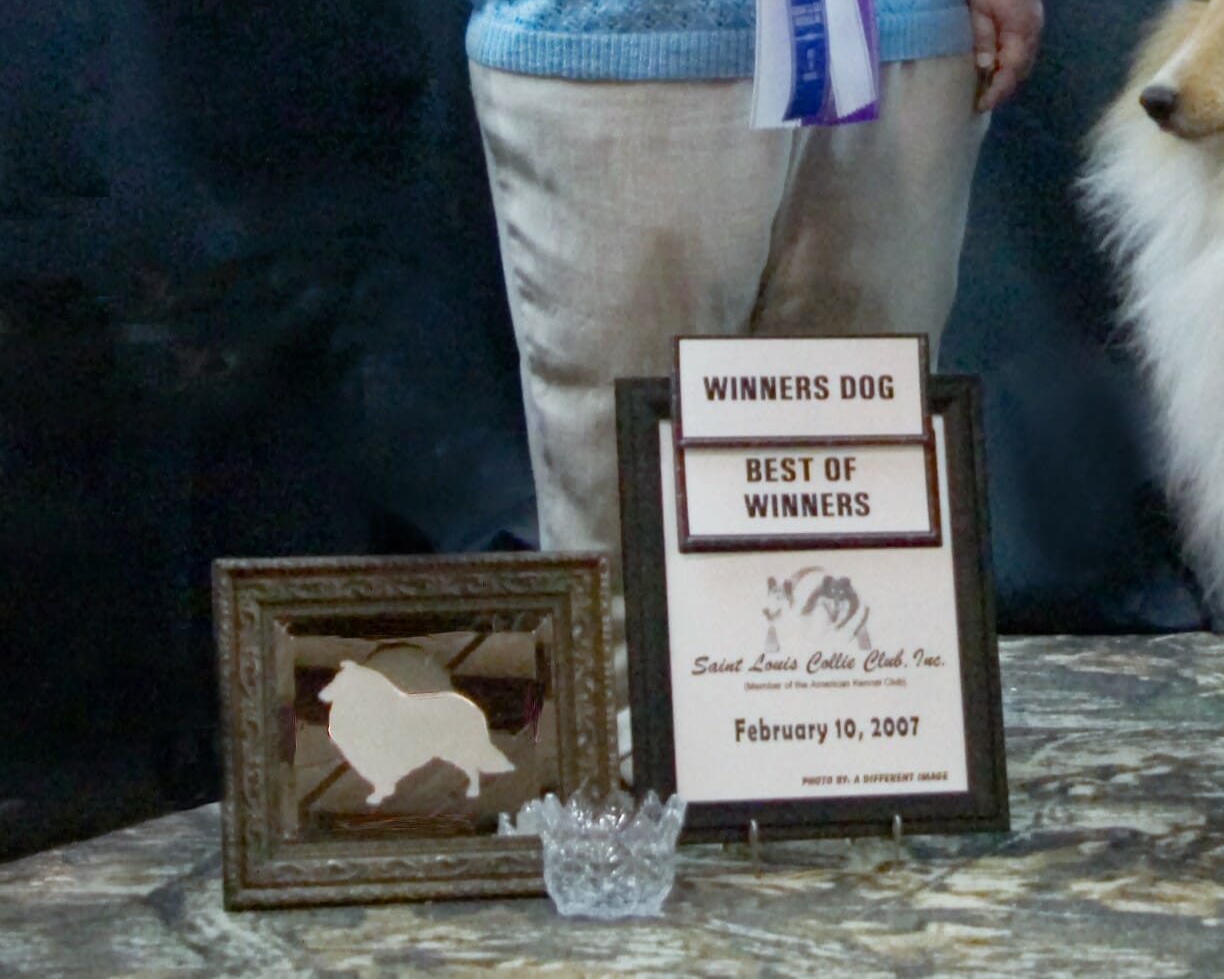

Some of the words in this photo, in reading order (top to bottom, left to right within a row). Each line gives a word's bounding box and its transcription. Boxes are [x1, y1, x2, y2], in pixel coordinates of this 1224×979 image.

[704, 375, 829, 401] WINNERS
[840, 374, 895, 400] DOG
[746, 458, 813, 482] BEST
[824, 457, 857, 481] OF
[744, 492, 871, 518] WINNERS
[691, 655, 743, 675] Saint
[747, 653, 798, 672] Louis
[806, 651, 855, 674] Collie
[913, 648, 945, 667] Inc.
[784, 680, 793, 689] of
[795, 680, 808, 689] the
[735, 718, 828, 744] February
[835, 719, 864, 740] 10,
[870, 716, 920, 738] 2007
[801, 776, 833, 786] PHOTO
[854, 775, 860, 784] A
[863, 772, 914, 784] DIFFERENT
[917, 771, 949, 782] IMAGE
